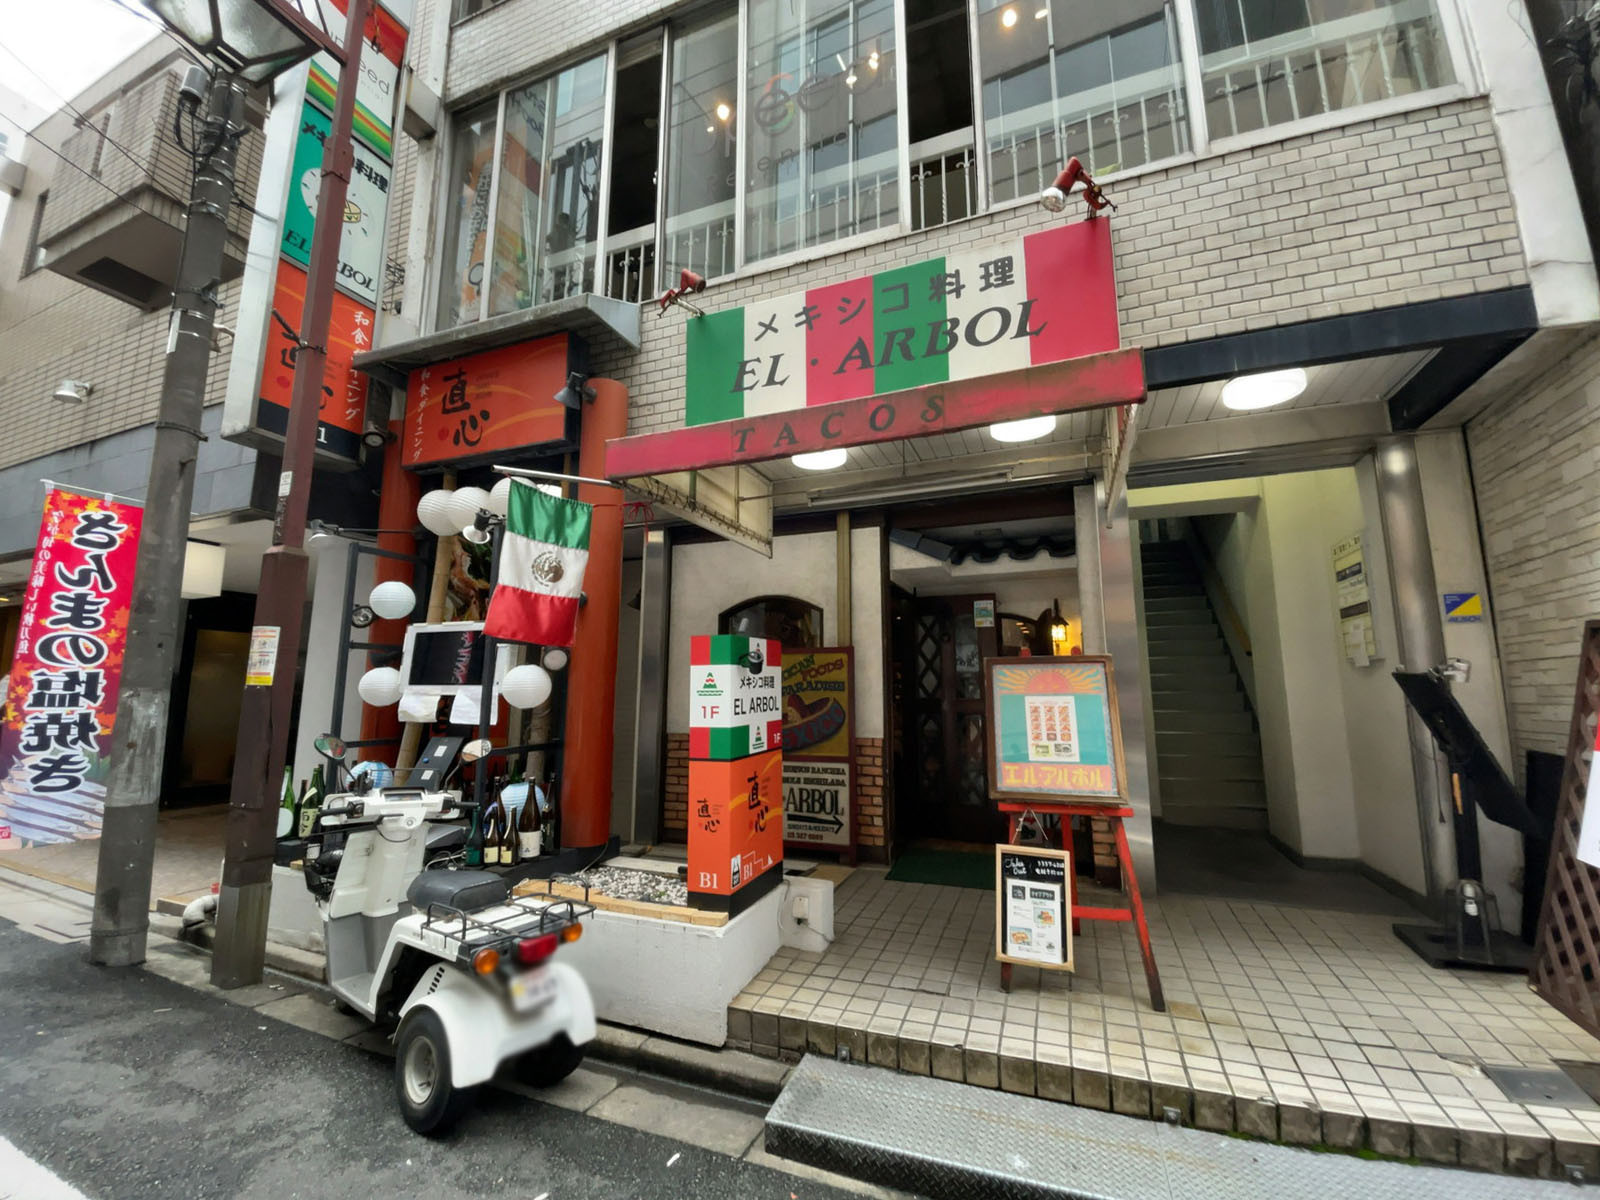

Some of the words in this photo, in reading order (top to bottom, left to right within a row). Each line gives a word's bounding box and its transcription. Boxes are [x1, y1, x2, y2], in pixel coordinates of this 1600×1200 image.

[754, 254, 1016, 342] メキシコ料理
[729, 355, 791, 394] EL
[832, 297, 1049, 375] ARBOL
[441, 367, 491, 447] 直心
[734, 394, 946, 454] TACOS
[740, 676, 775, 689] メキシコ料理
[701, 705, 720, 719] 1F
[733, 698, 746, 716] EL
[749, 696, 779, 714] ARBOL
[773, 732, 781, 744] 1F
[697, 798, 720, 833] 直心
[747, 770, 769, 833] 直心
[699, 871, 719, 889] B1
